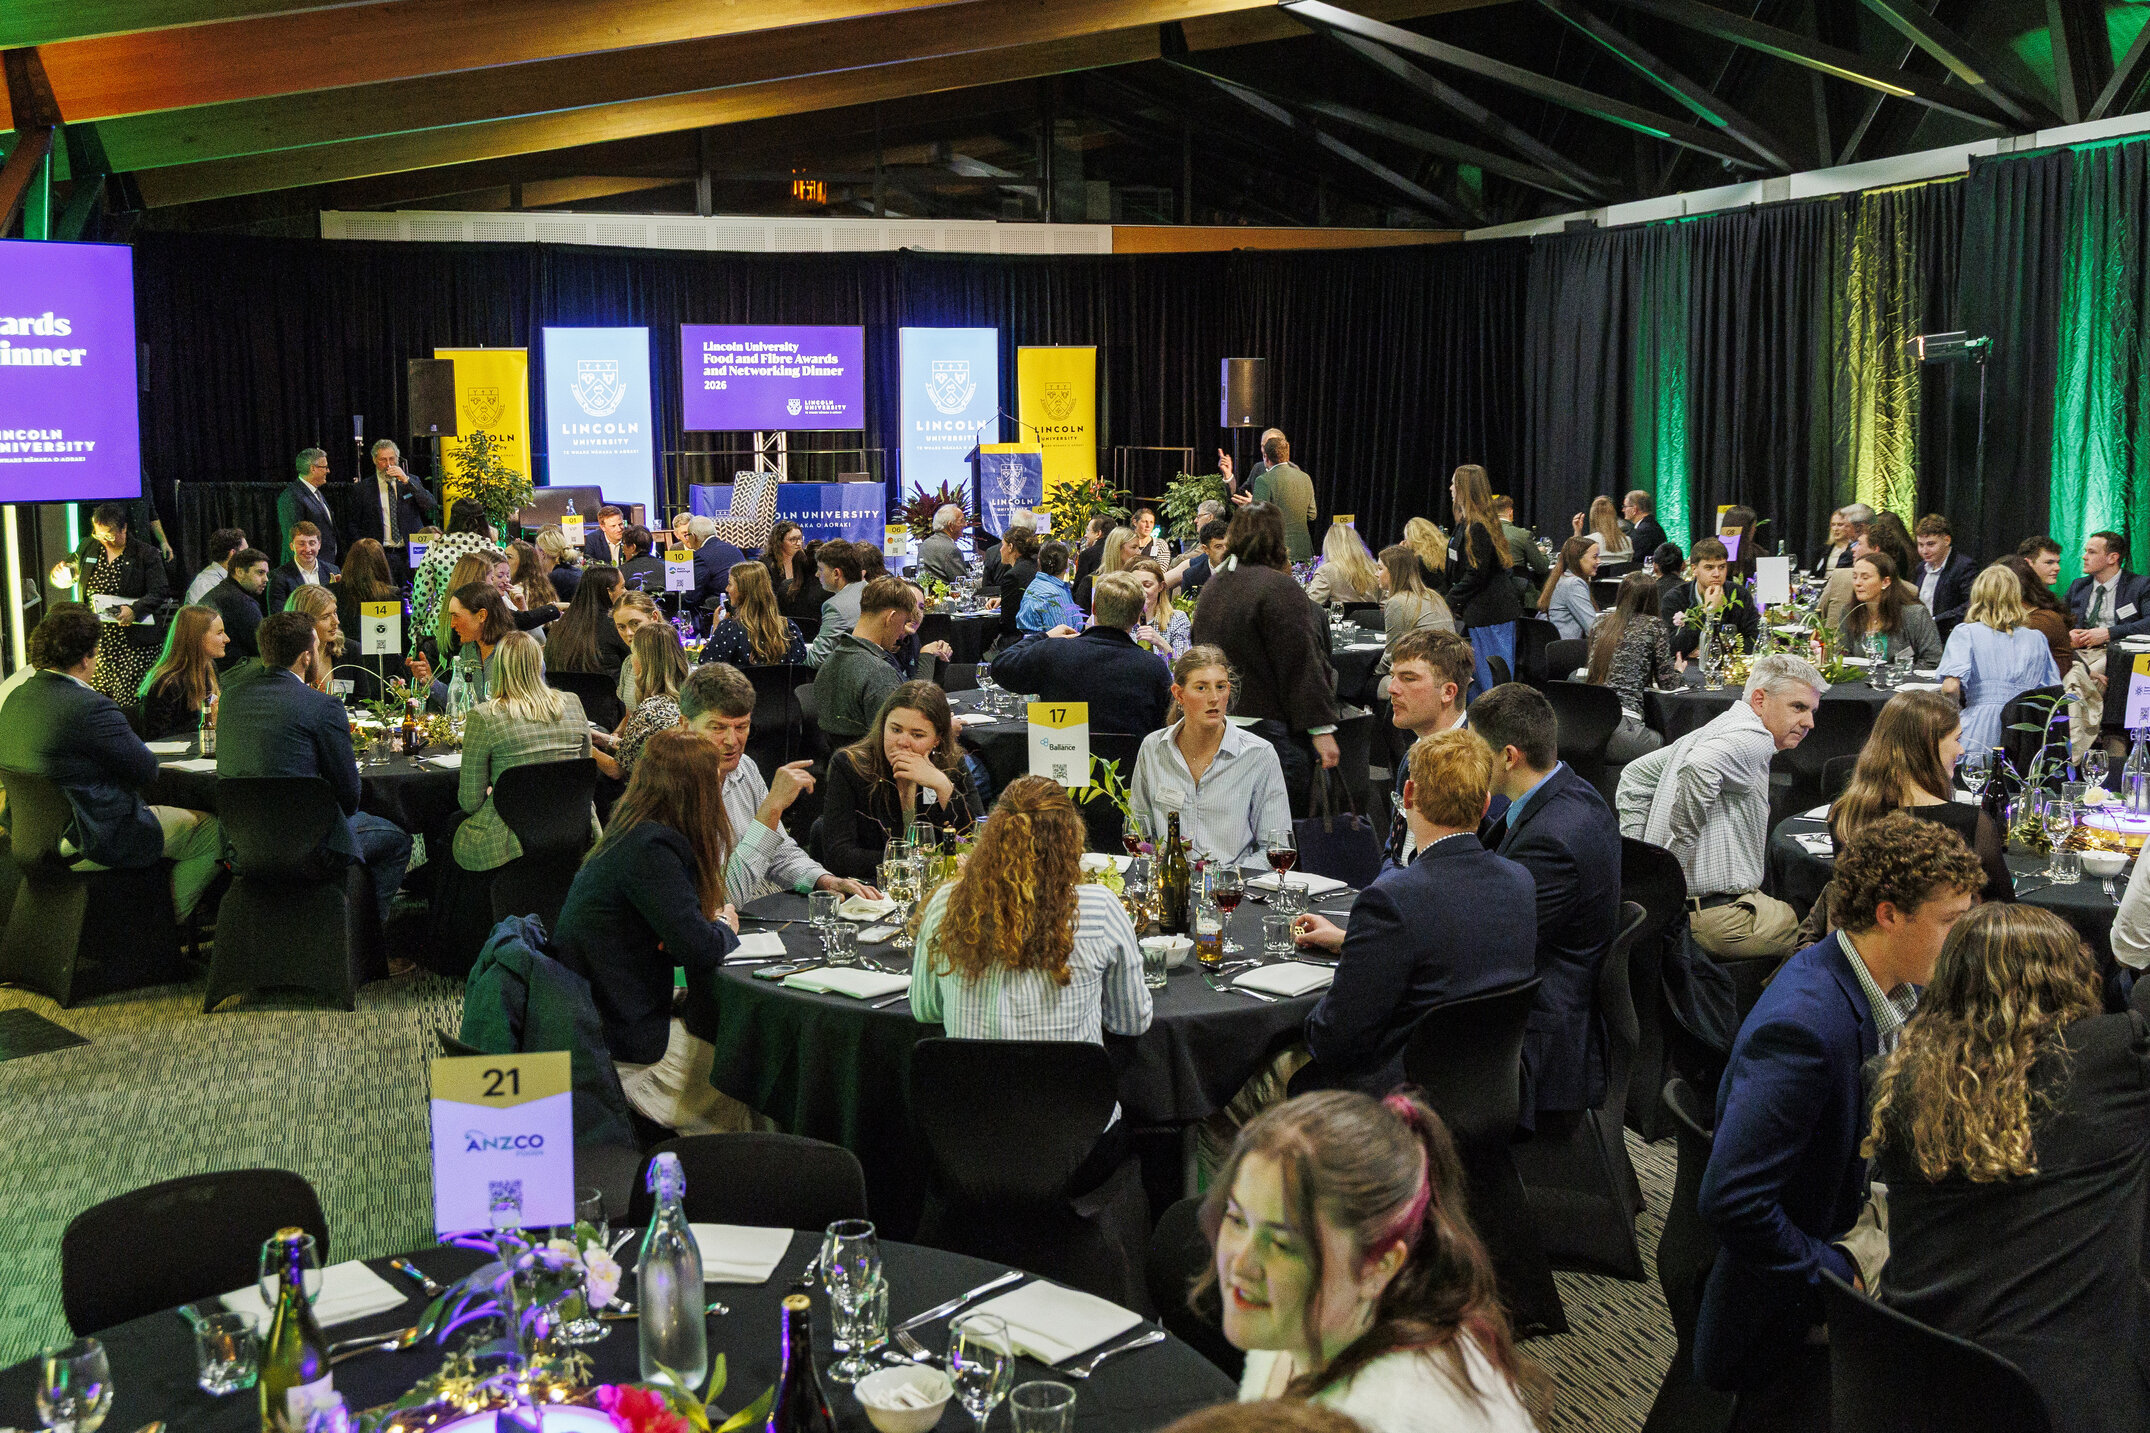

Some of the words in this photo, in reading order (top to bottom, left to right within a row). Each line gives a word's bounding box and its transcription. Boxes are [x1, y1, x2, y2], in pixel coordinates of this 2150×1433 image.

[703, 341, 744, 352] Lincoln
[745, 341, 799, 354] University
[703, 353, 734, 364] Food
[735, 353, 759, 364] and
[760, 353, 793, 364] Fibre
[794, 353, 839, 364] Awards
[703, 365, 727, 376] and
[728, 365, 800, 378] Networking
[801, 365, 844, 376] Dinner
[704, 380, 727, 390] 2026
[561, 422, 639, 435] LINCOLN
[916, 420, 987, 431] LINCOLN
[1034, 425, 1084, 434] LINCOLN
[0, 429, 63, 441] NCOLN
[925, 434, 977, 442] UNIVERSITY
[572, 438, 629, 446] UNIVERSITY
[991, 498, 1034, 506] LINCOLN
[802, 510, 880, 519] UNIVERSITY
[417, 535, 427, 543] 07
[674, 553, 684, 561] 10
[375, 605, 387, 615] 14
[1049, 708, 1067, 723] 17
[1049, 743, 1076, 751] Ballance
[482, 1067, 521, 1097] 21
[466, 1134, 544, 1153] ANZCO
